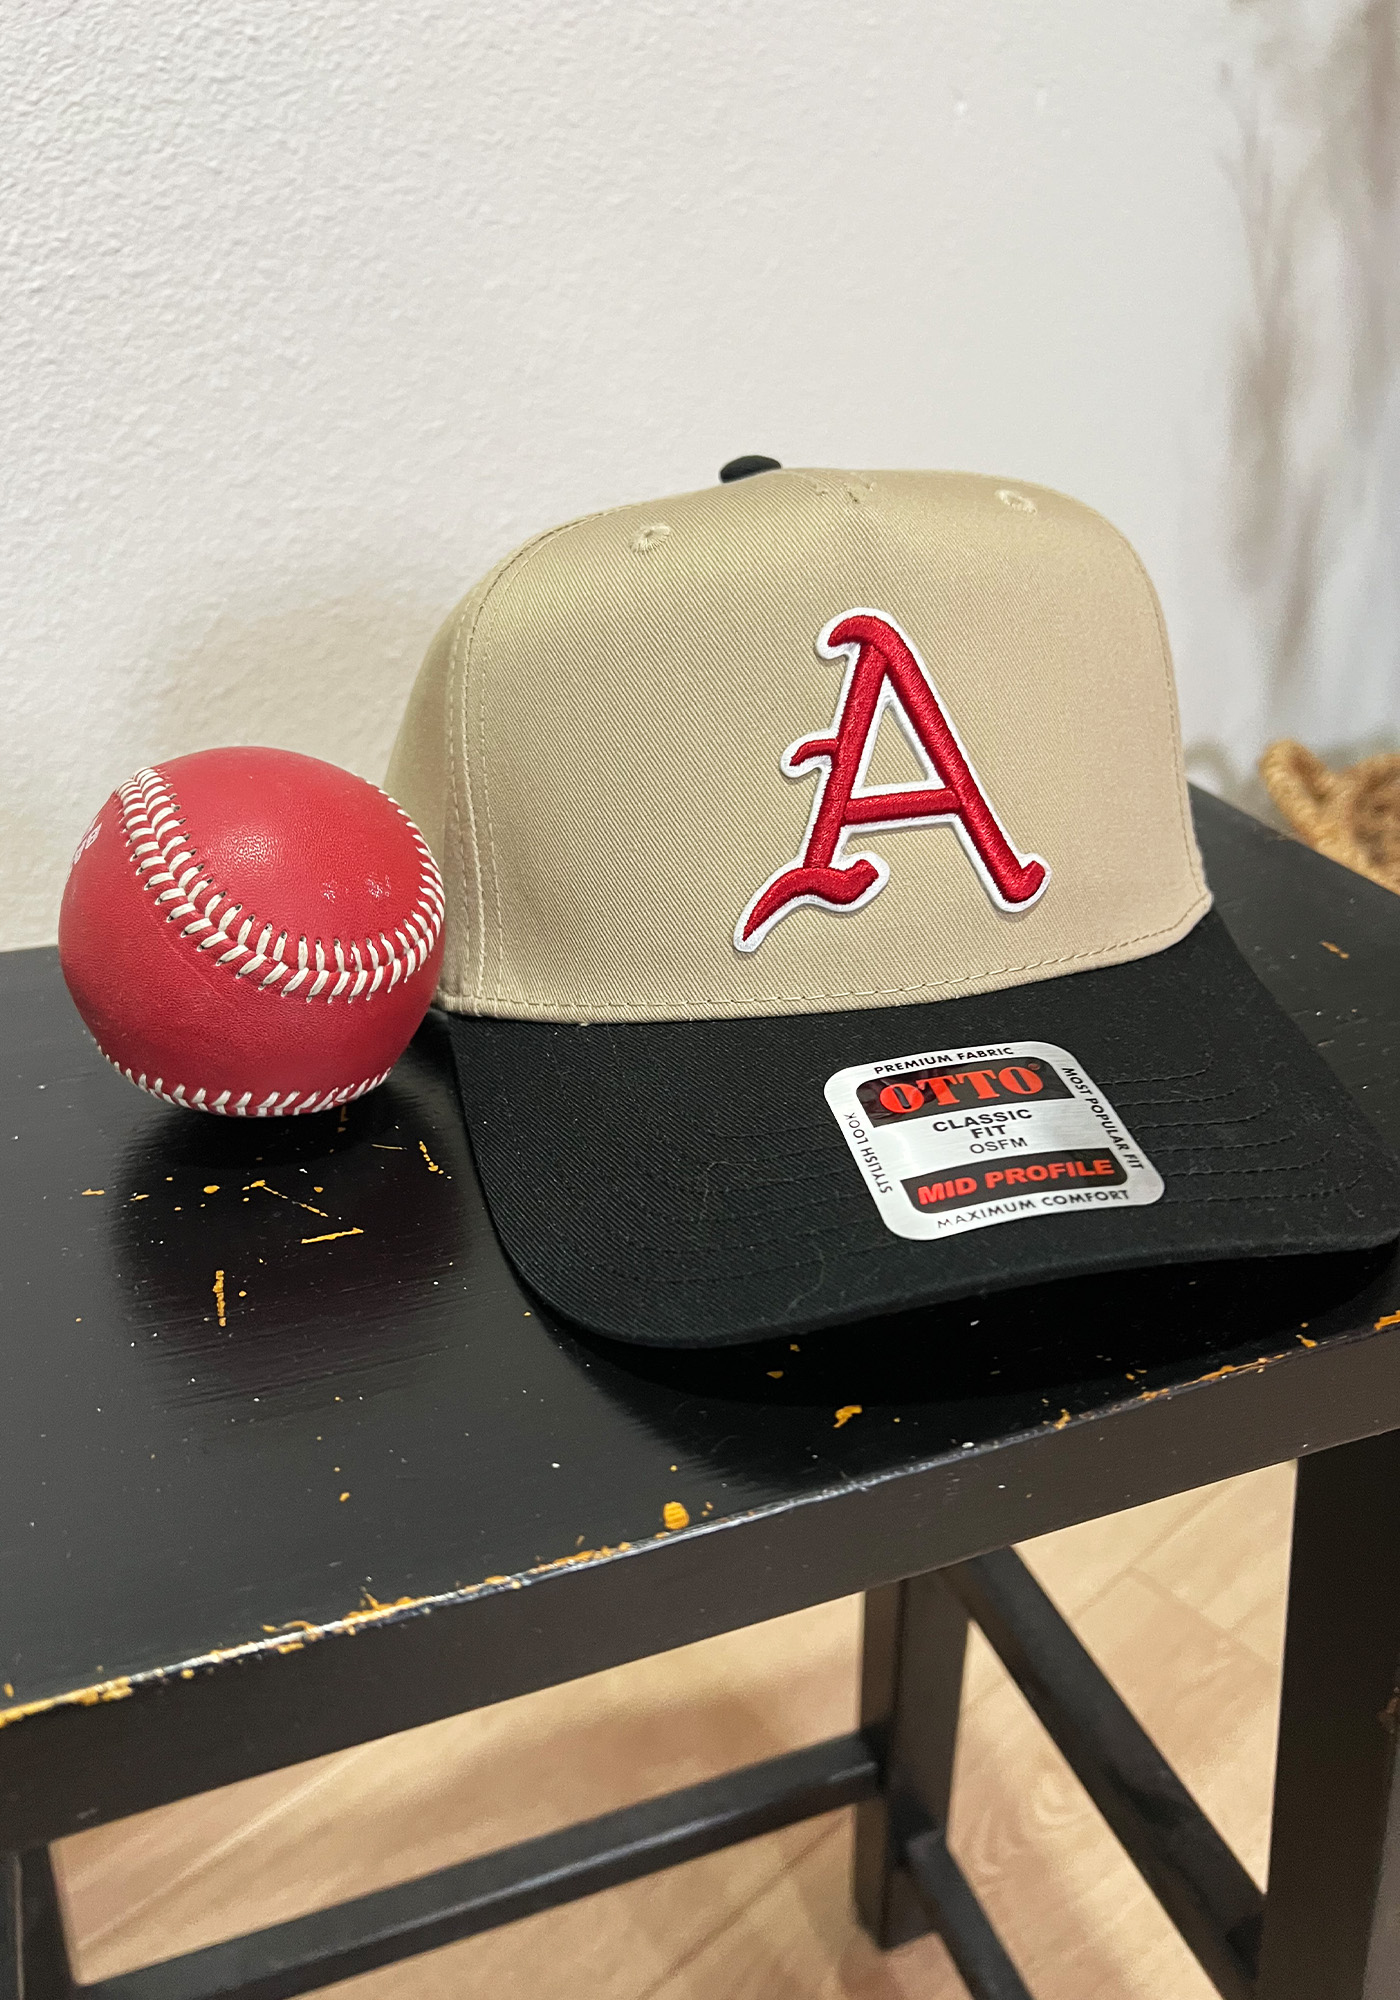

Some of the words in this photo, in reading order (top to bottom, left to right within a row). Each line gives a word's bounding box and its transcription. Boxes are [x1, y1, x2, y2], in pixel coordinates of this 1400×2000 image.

[735, 608, 1051, 951] A
[873, 1053, 953, 1075] PREMIUM
[957, 1047, 1015, 1062] FABRIC
[879, 1066, 1044, 1114] OTTO
[843, 1112, 869, 1145] LOOK
[932, 1109, 1033, 1133] CLASSIC
[972, 1124, 1007, 1139] FIT
[1061, 1067, 1093, 1095] MOST
[1084, 1097, 1130, 1151] POPULAR
[1123, 1154, 1145, 1170] FIT
[969, 1137, 1028, 1155] OSFM
[860, 1147, 893, 1194] STYLISH
[917, 1179, 977, 1205] MID
[985, 1159, 1115, 1189] PROFILE
[937, 1199, 1037, 1229] MAXIMUM
[1041, 1189, 1130, 1207] COMFORT
